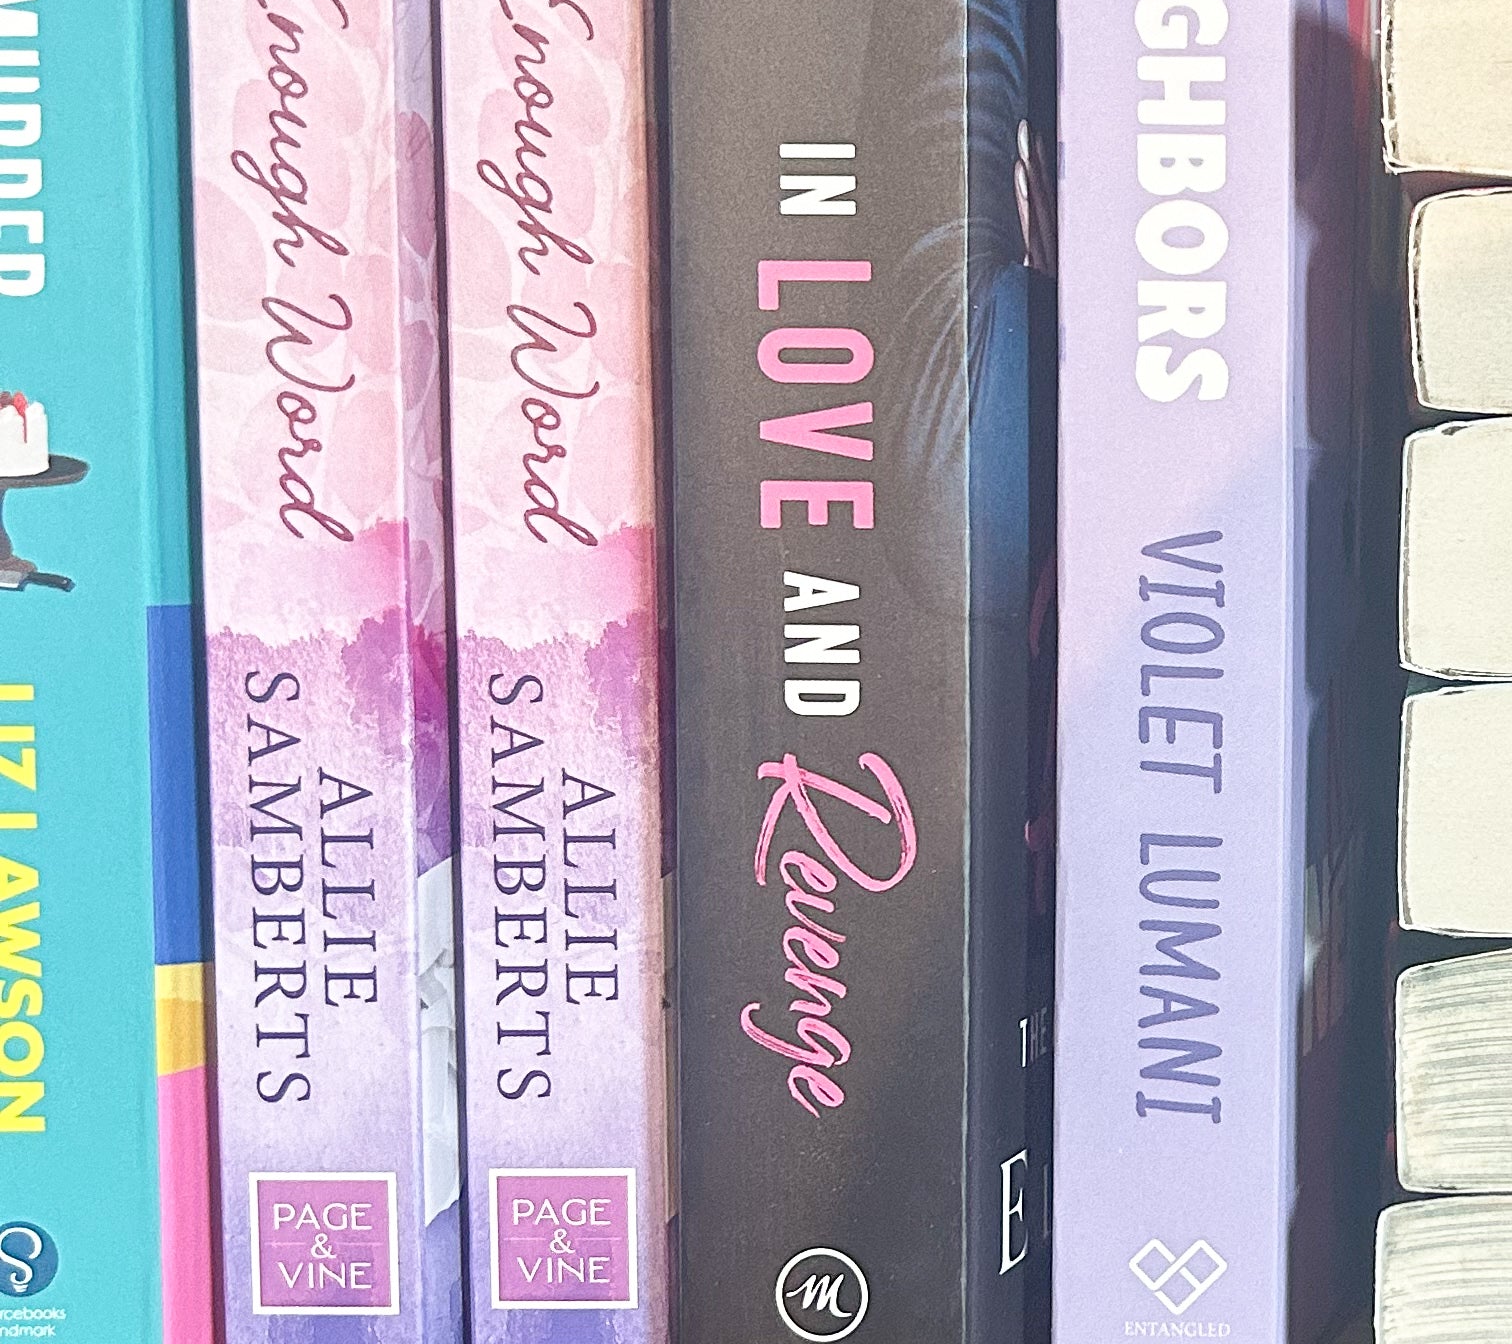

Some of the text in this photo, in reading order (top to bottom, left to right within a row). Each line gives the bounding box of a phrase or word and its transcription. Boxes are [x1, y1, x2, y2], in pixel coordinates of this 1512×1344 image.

[261, 292, 355, 542] Word
[505, 301, 600, 546] Word
[740, 142, 918, 1119] IN LOVE AND Revenge
[243, 670, 312, 1104] SAMBERTS
[317, 766, 379, 1008] ALLIE
[488, 673, 552, 1100] SAMBERTS
[561, 767, 619, 1006] ALLIE
[1135, 528, 1227, 1125] VIOLET LUMANI
[272, 1202, 373, 1232] PAGE
[278, 1261, 373, 1290] VINE
[310, 1232, 337, 1260] &
[511, 1198, 612, 1228] PAGE
[516, 1256, 611, 1285] VINE
[548, 1228, 577, 1255] &
[1124, 1321, 1231, 1337] ENTANGLED
